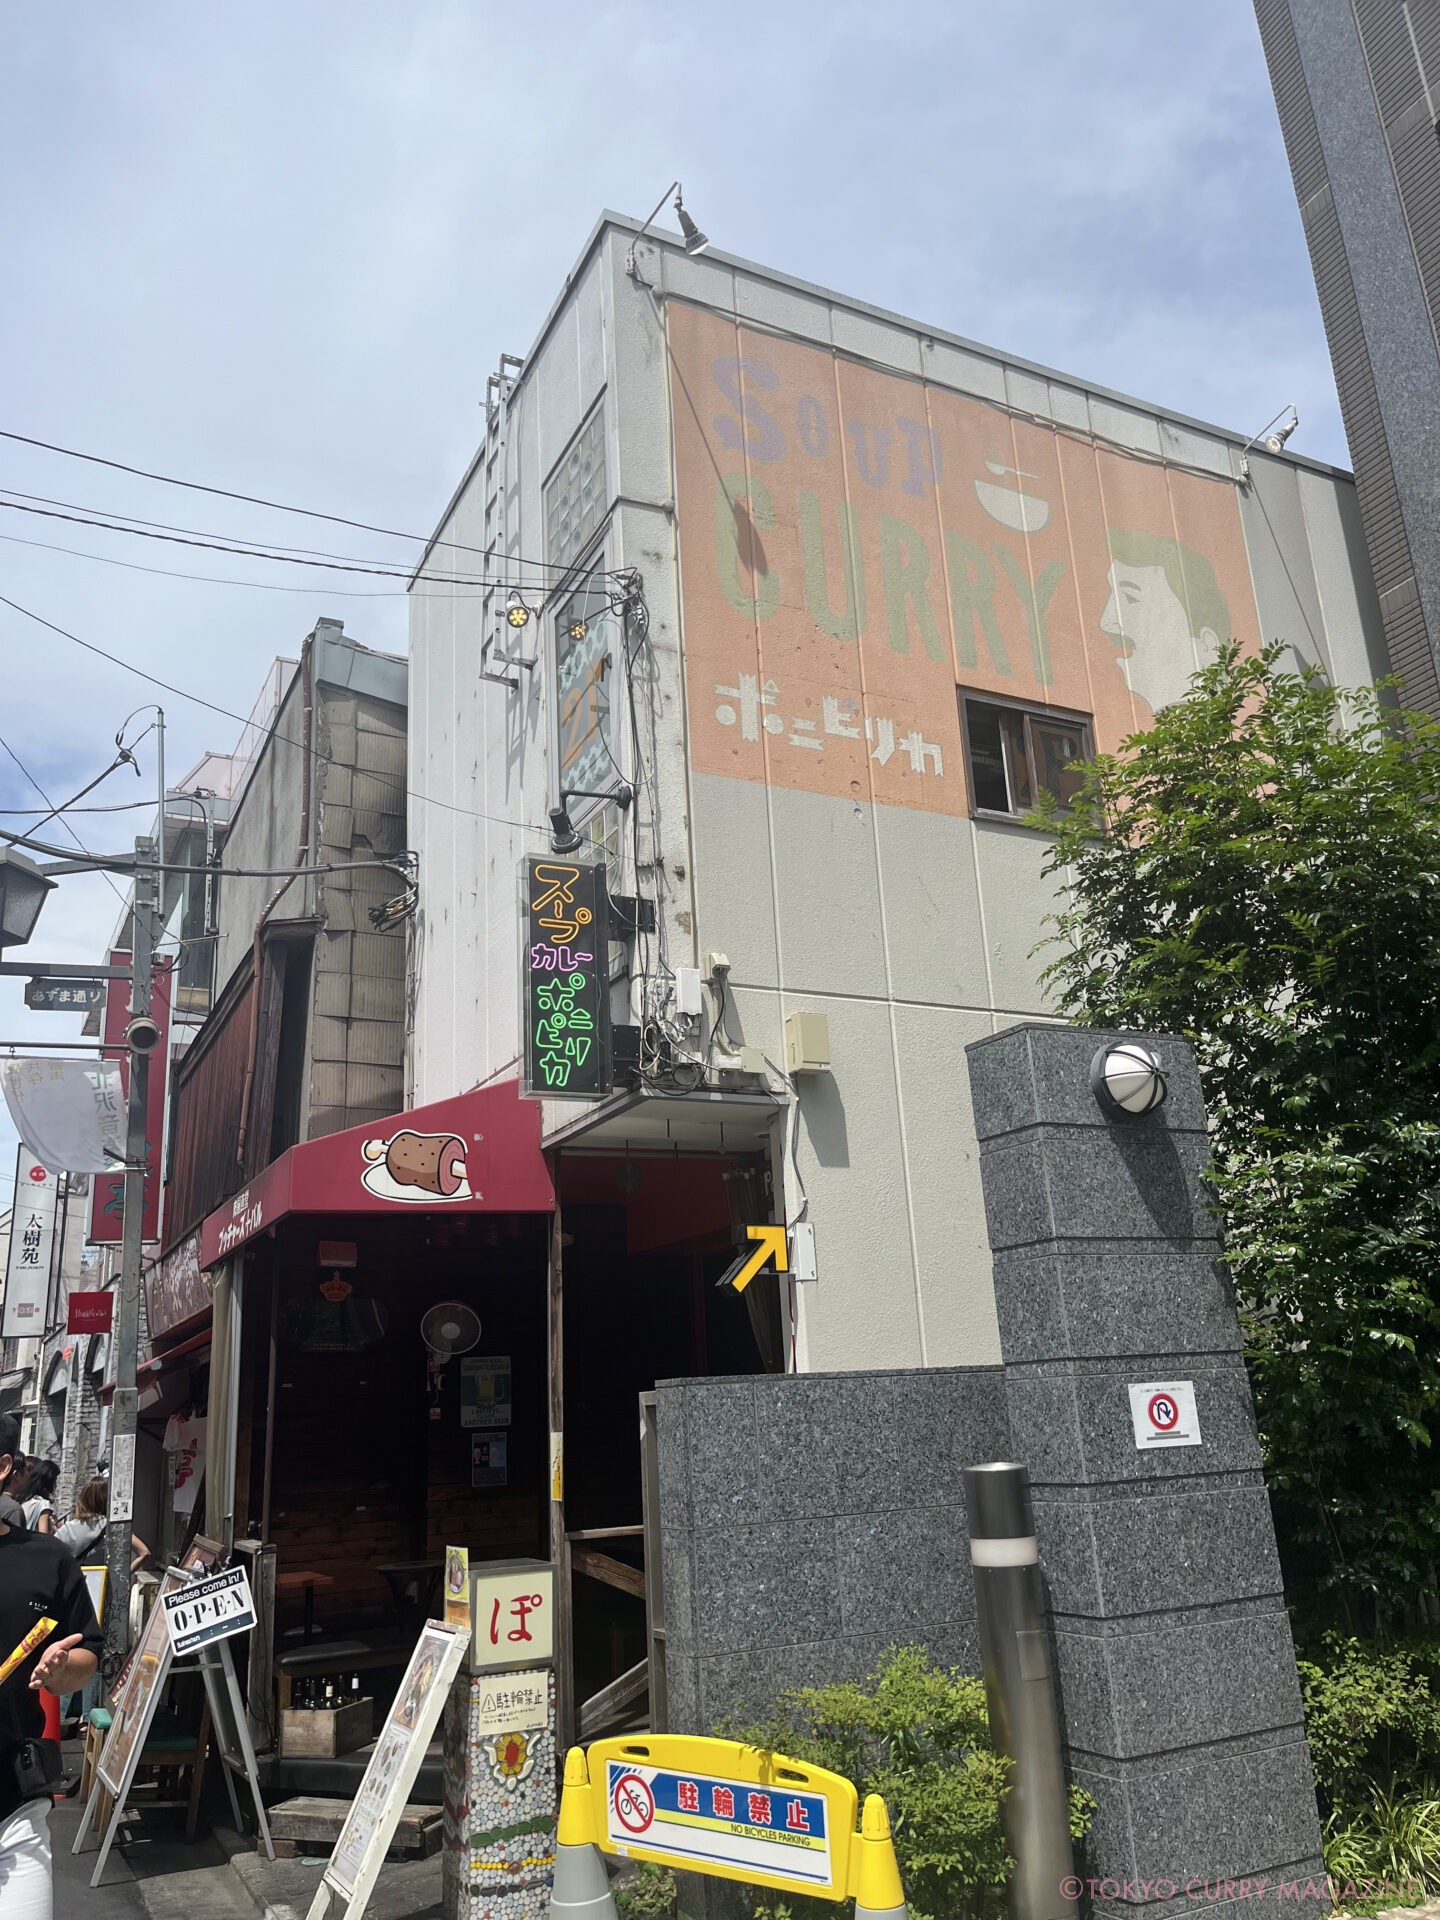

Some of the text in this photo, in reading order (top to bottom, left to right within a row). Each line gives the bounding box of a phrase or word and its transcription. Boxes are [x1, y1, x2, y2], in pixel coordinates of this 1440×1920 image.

[714, 471, 1067, 687] CURRY
[532, 864, 593, 944] スープ
[531, 943, 594, 972] カレー
[32, 987, 101, 1003] あずま通り
[168, 1589, 200, 1607] Please
[201, 1579, 228, 1594] come
[490, 1593, 543, 1645] ぽ
[496, 1688, 543, 1710] 駐輪禁止
[677, 1780, 810, 1832] 駐輪禁止
[731, 1823, 811, 1846] NO BICYCLES PARKING
